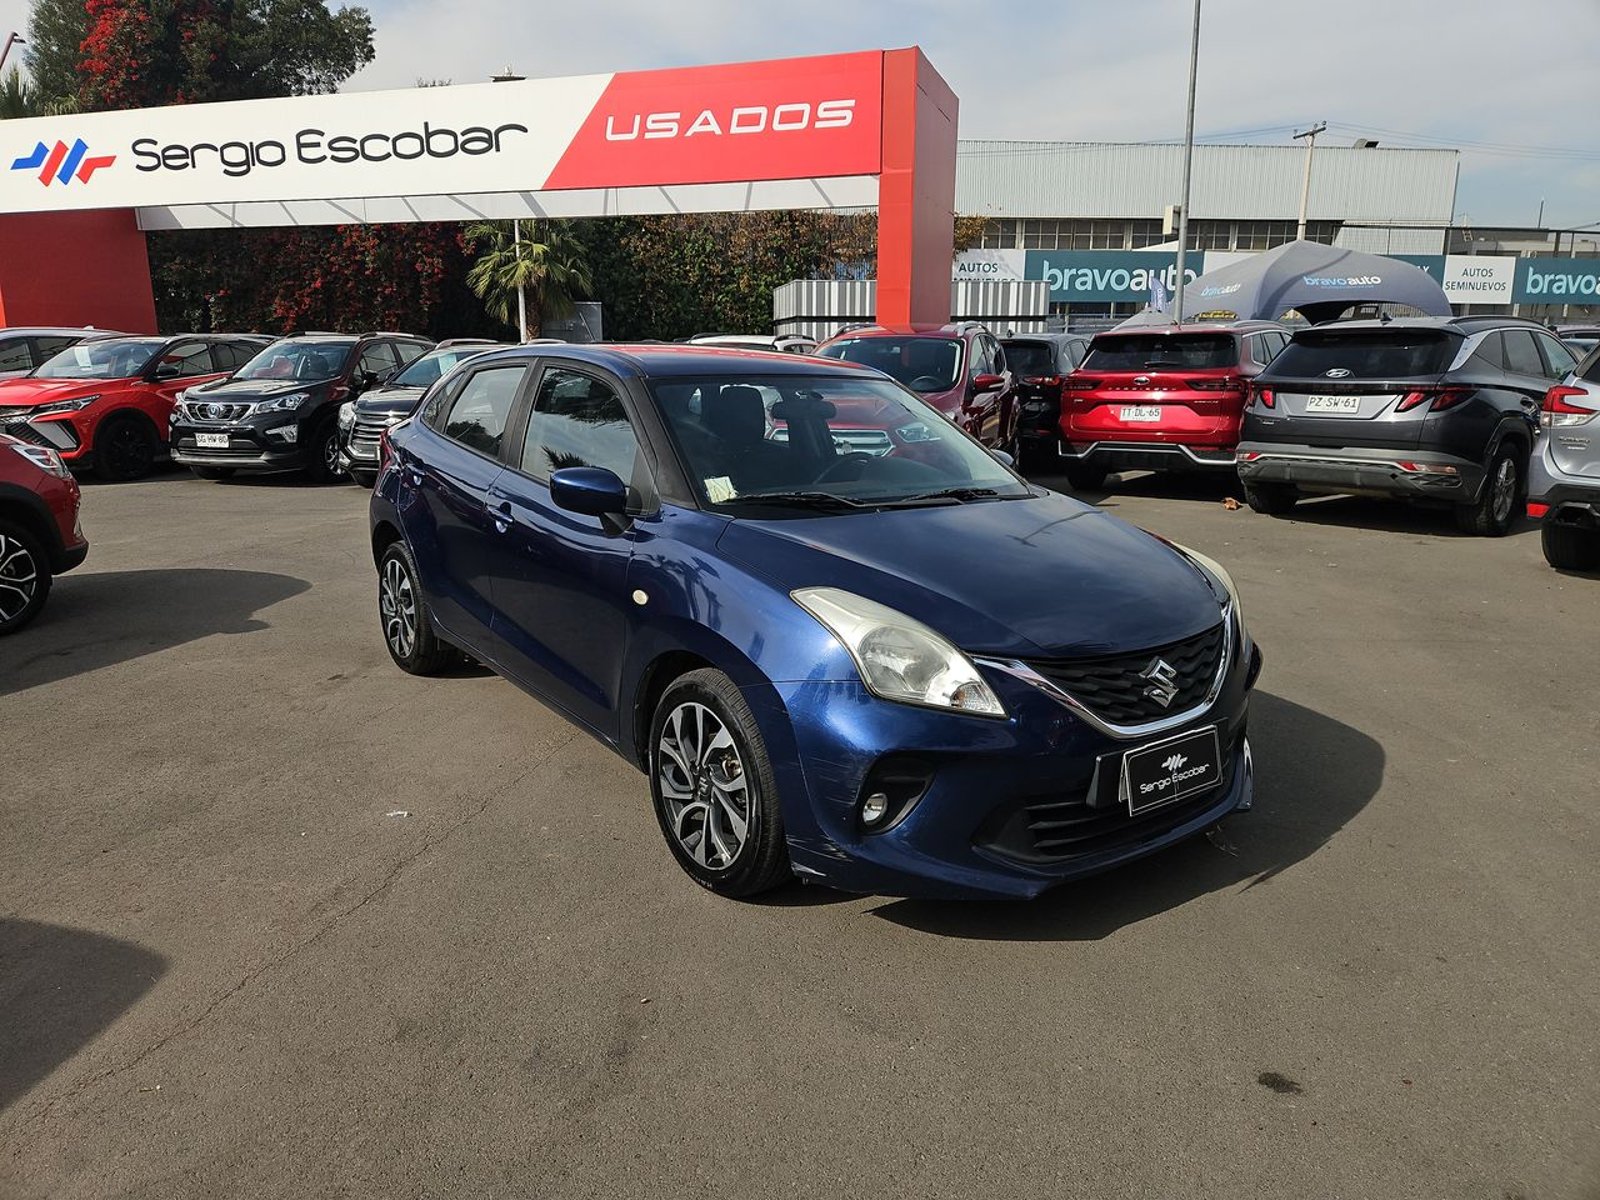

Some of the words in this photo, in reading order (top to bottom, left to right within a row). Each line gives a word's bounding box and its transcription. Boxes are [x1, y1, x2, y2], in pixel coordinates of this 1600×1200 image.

[605, 99, 856, 141] USADOS
[131, 138, 286, 177] Sergio
[295, 121, 529, 164] Escobar
[958, 262, 998, 274] AUTOS
[1462, 268, 1494, 278] AUTOS
[1303, 275, 1382, 286] bravoauto
[1445, 281, 1507, 291] SEMINUEVOS
[1525, 266, 1600, 295] bravo
[1172, 763, 1210, 783] Escobar
